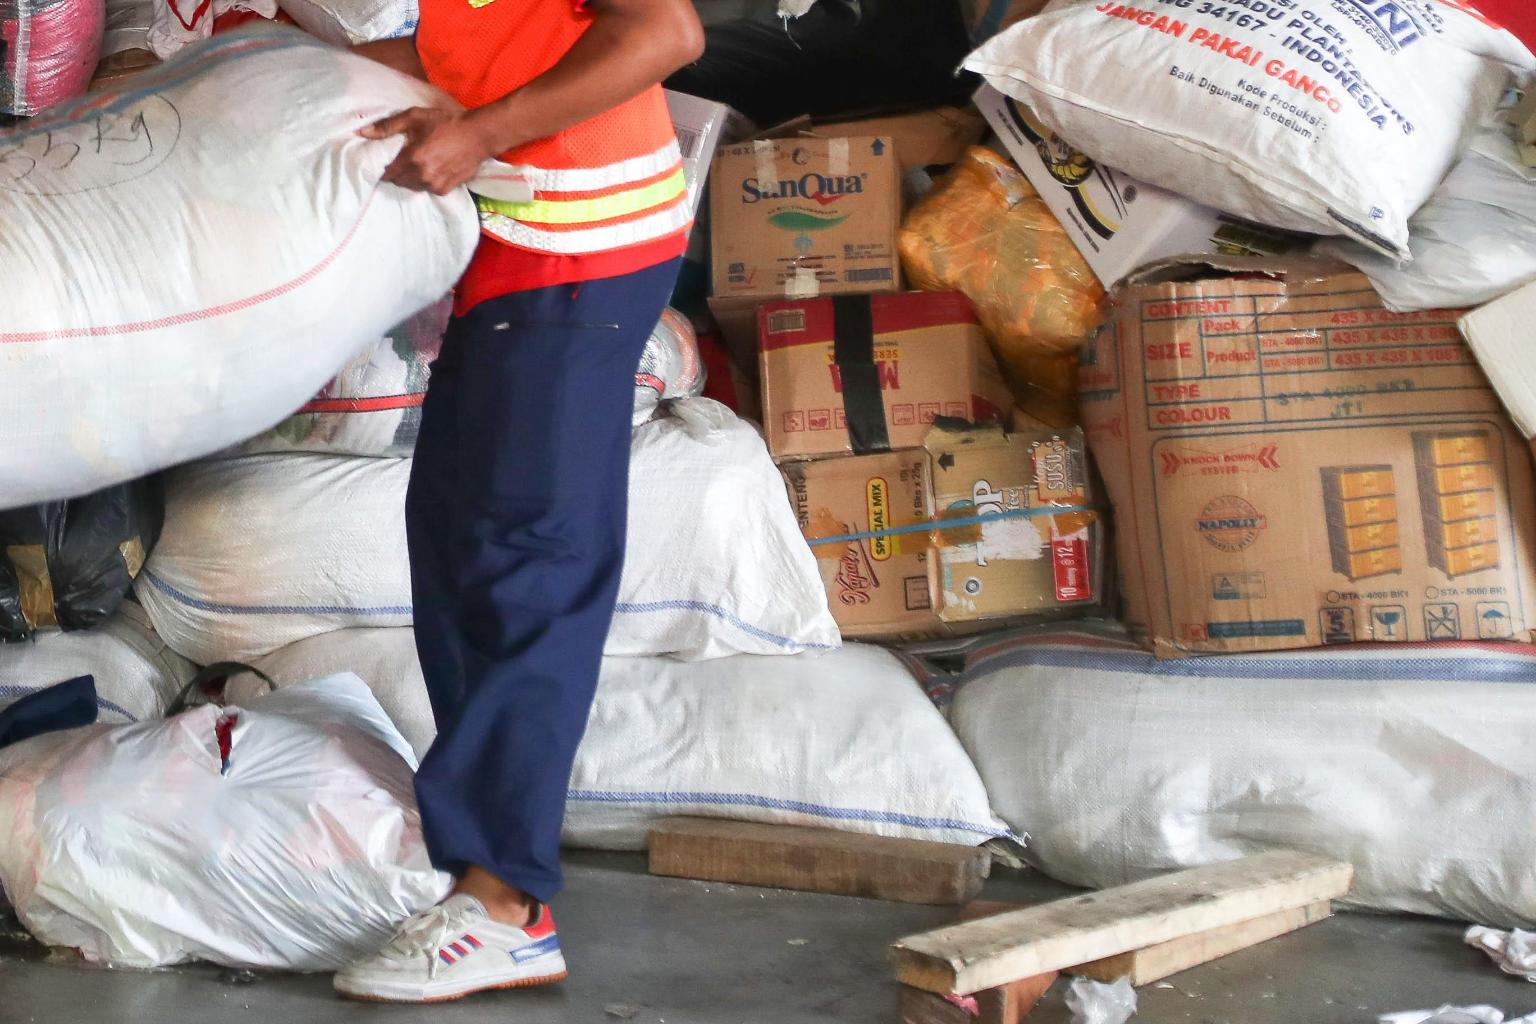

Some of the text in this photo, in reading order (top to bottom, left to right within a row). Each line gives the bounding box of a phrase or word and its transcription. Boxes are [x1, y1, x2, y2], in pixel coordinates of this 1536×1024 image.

[1301, 9, 1346, 45] OLEH
[1096, 0, 1343, 115] JANGAN PAKAI GANCO
[1196, 2, 1264, 31] 34167
[1281, 36, 1390, 131] INDONESIA
[1168, 64, 1314, 140] Baik Digunakan Sebelum
[1237, 77, 1322, 130] Kode Produksi
[1147, 298, 1231, 316] CONTENT
[1204, 318, 1241, 334] Pack
[1147, 341, 1194, 362] SIZE
[1206, 347, 1257, 364] Product
[1153, 383, 1200, 401] TYPE
[1156, 406, 1232, 423] COLOUR
[1047, 454, 1064, 490] SUSU
[870, 483, 886, 556] SPEIAL MIX
[1199, 518, 1259, 531] NAPOLLY
